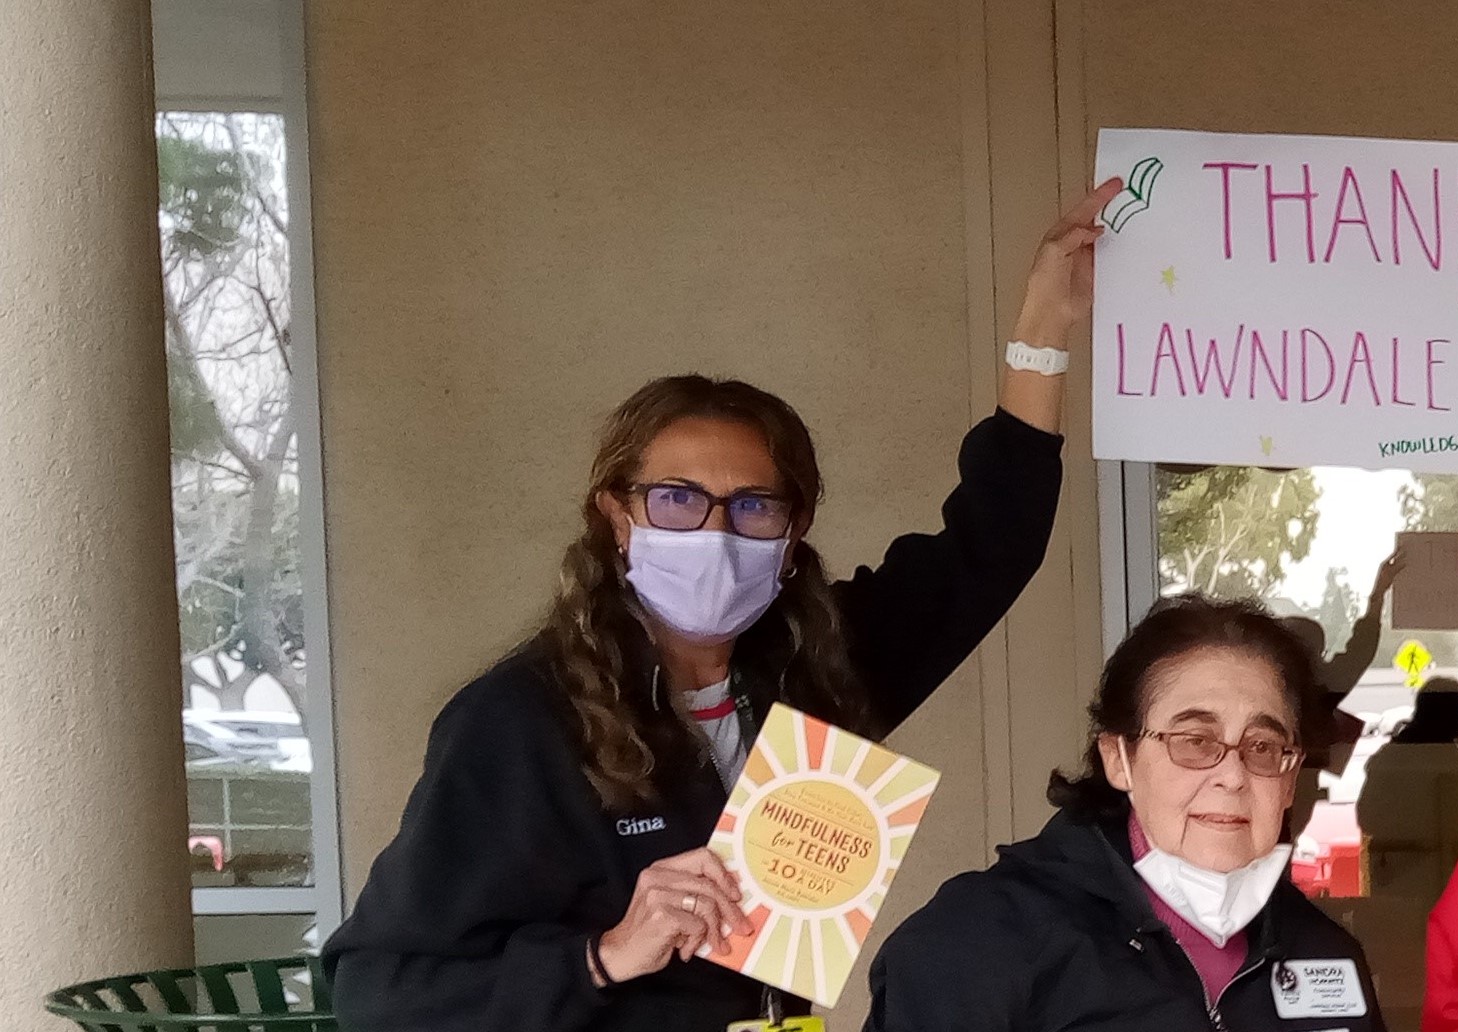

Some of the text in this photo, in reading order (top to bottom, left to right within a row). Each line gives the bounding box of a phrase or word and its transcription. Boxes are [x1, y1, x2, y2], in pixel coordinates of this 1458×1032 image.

[1115, 321, 1452, 412] LAWNDALE
[616, 817, 666, 836] Gina
[762, 800, 872, 858] MINDFULNESS
[768, 859, 796, 879] 10
[772, 832, 850, 873] for TEENS
